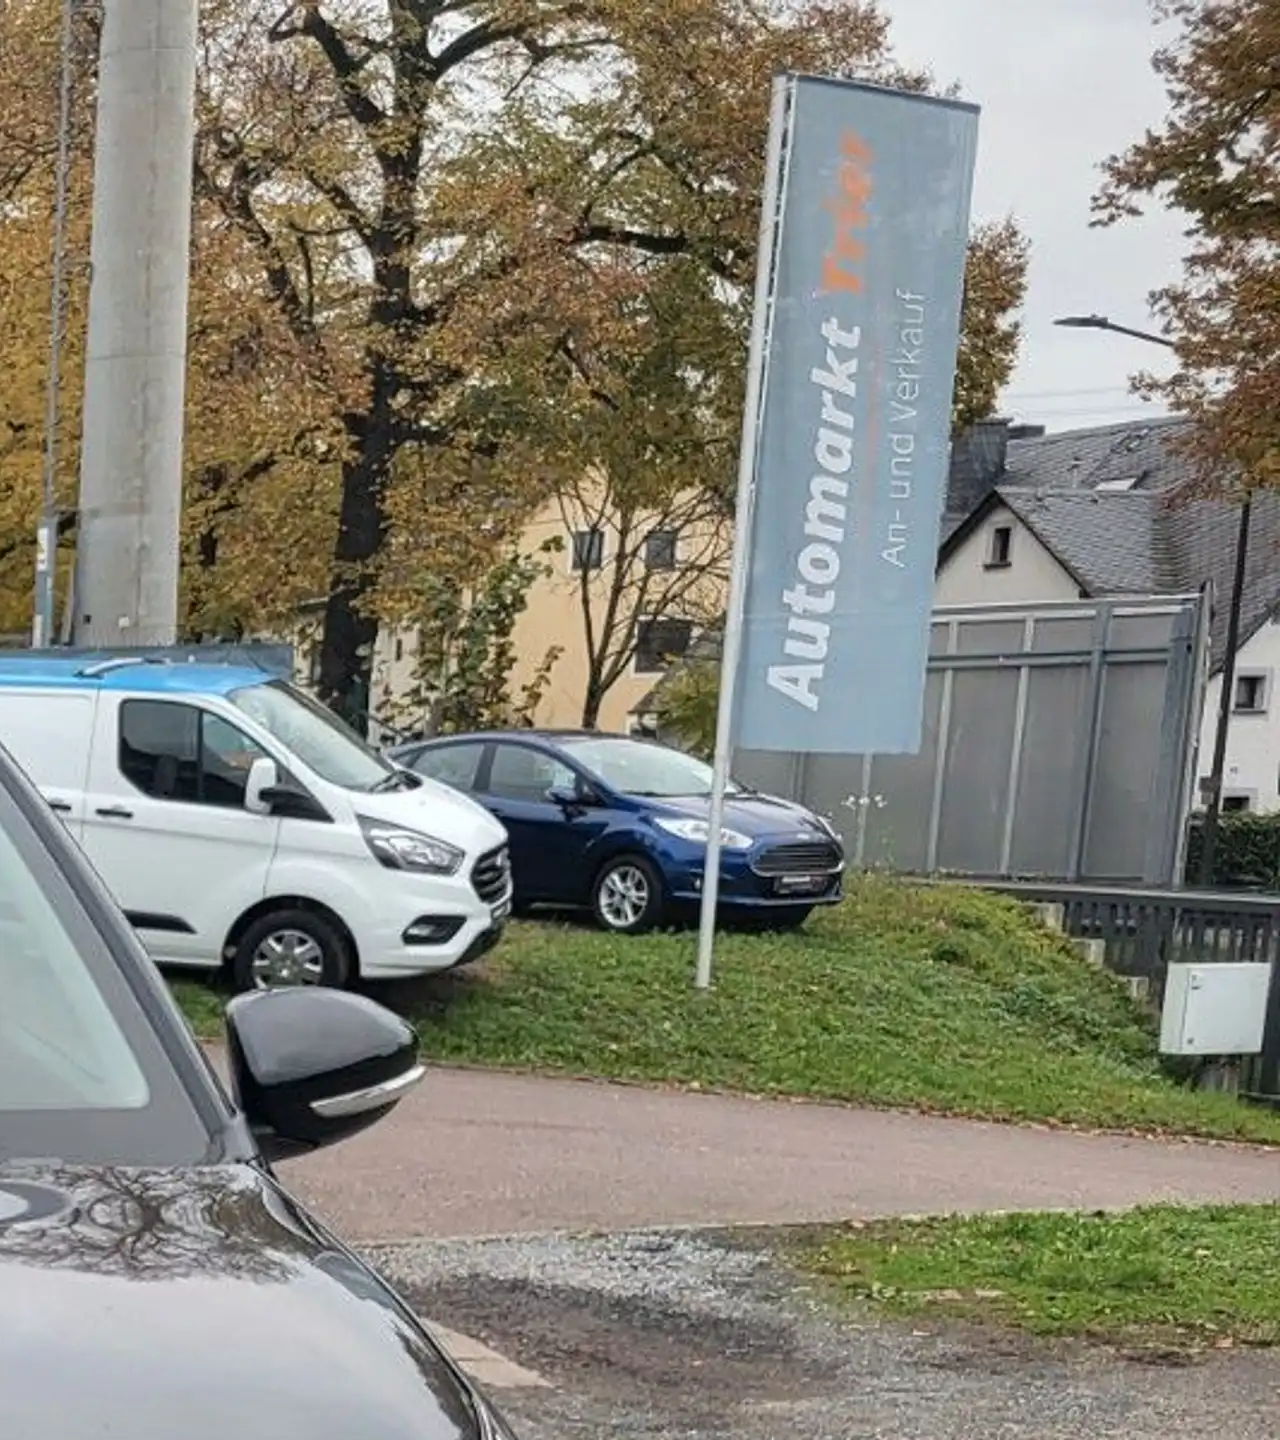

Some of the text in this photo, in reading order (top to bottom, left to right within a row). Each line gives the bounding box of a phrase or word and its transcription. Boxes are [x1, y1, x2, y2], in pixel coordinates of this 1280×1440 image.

[766, 130, 876, 713] Automarkt Trier
[881, 287, 928, 568] An- und Verkauf
